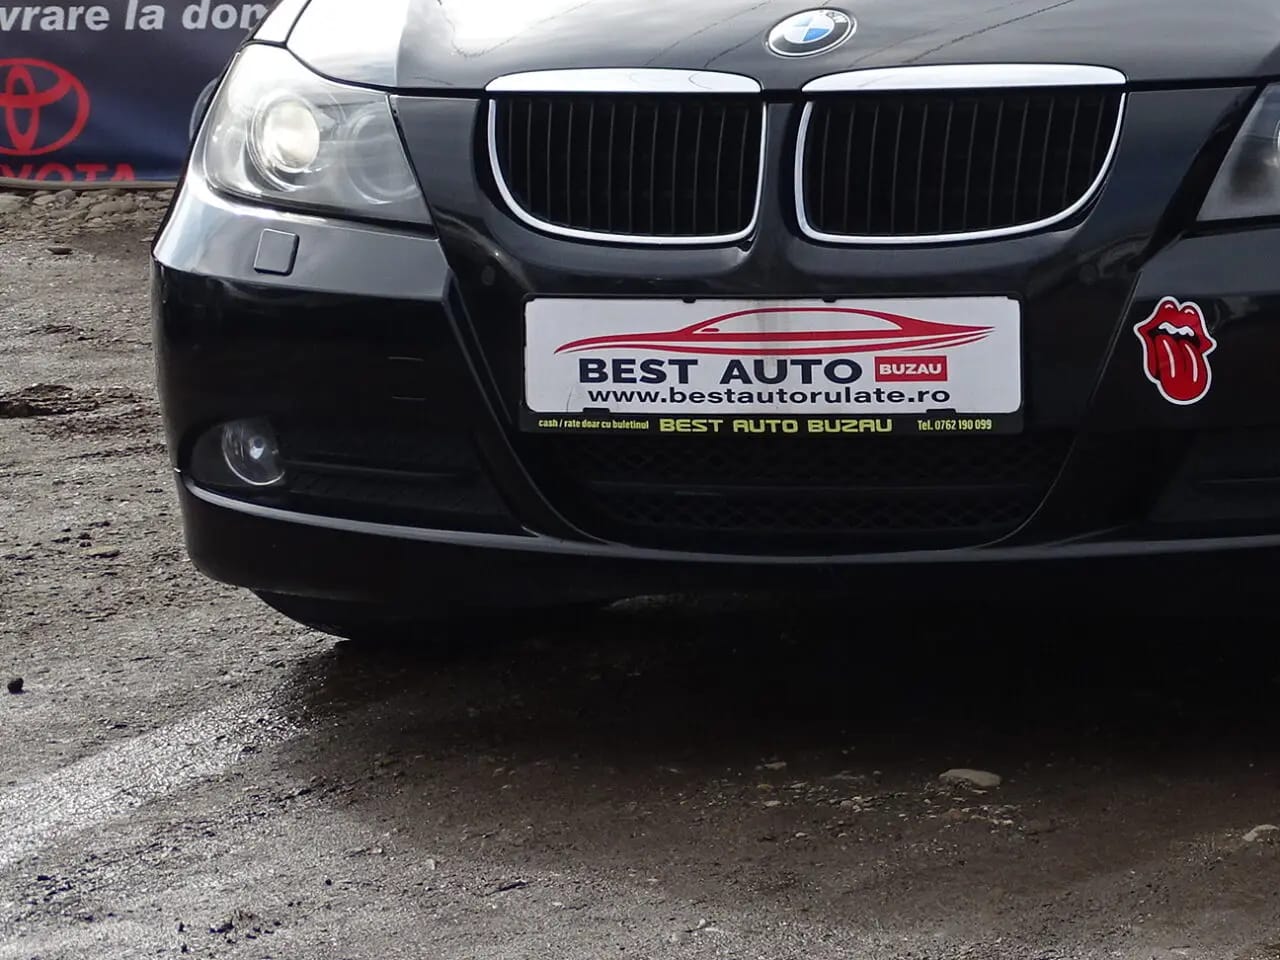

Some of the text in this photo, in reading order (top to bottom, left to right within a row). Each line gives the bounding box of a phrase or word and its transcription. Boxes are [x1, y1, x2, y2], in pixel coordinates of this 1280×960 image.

[578, 358, 863, 385] BEST AUTO
[879, 363, 942, 375] BUZAU
[587, 386, 951, 403] www.bestautorulate.ro
[538, 419, 558, 428] cash
[564, 419, 580, 428] rate
[581, 419, 600, 428] doar
[601, 420, 612, 428] cu
[659, 418, 724, 432] BEST
[732, 419, 799, 433] AUTO
[807, 419, 893, 433] BUZAU
[958, 419, 974, 430] 190
[975, 419, 993, 430] 099
